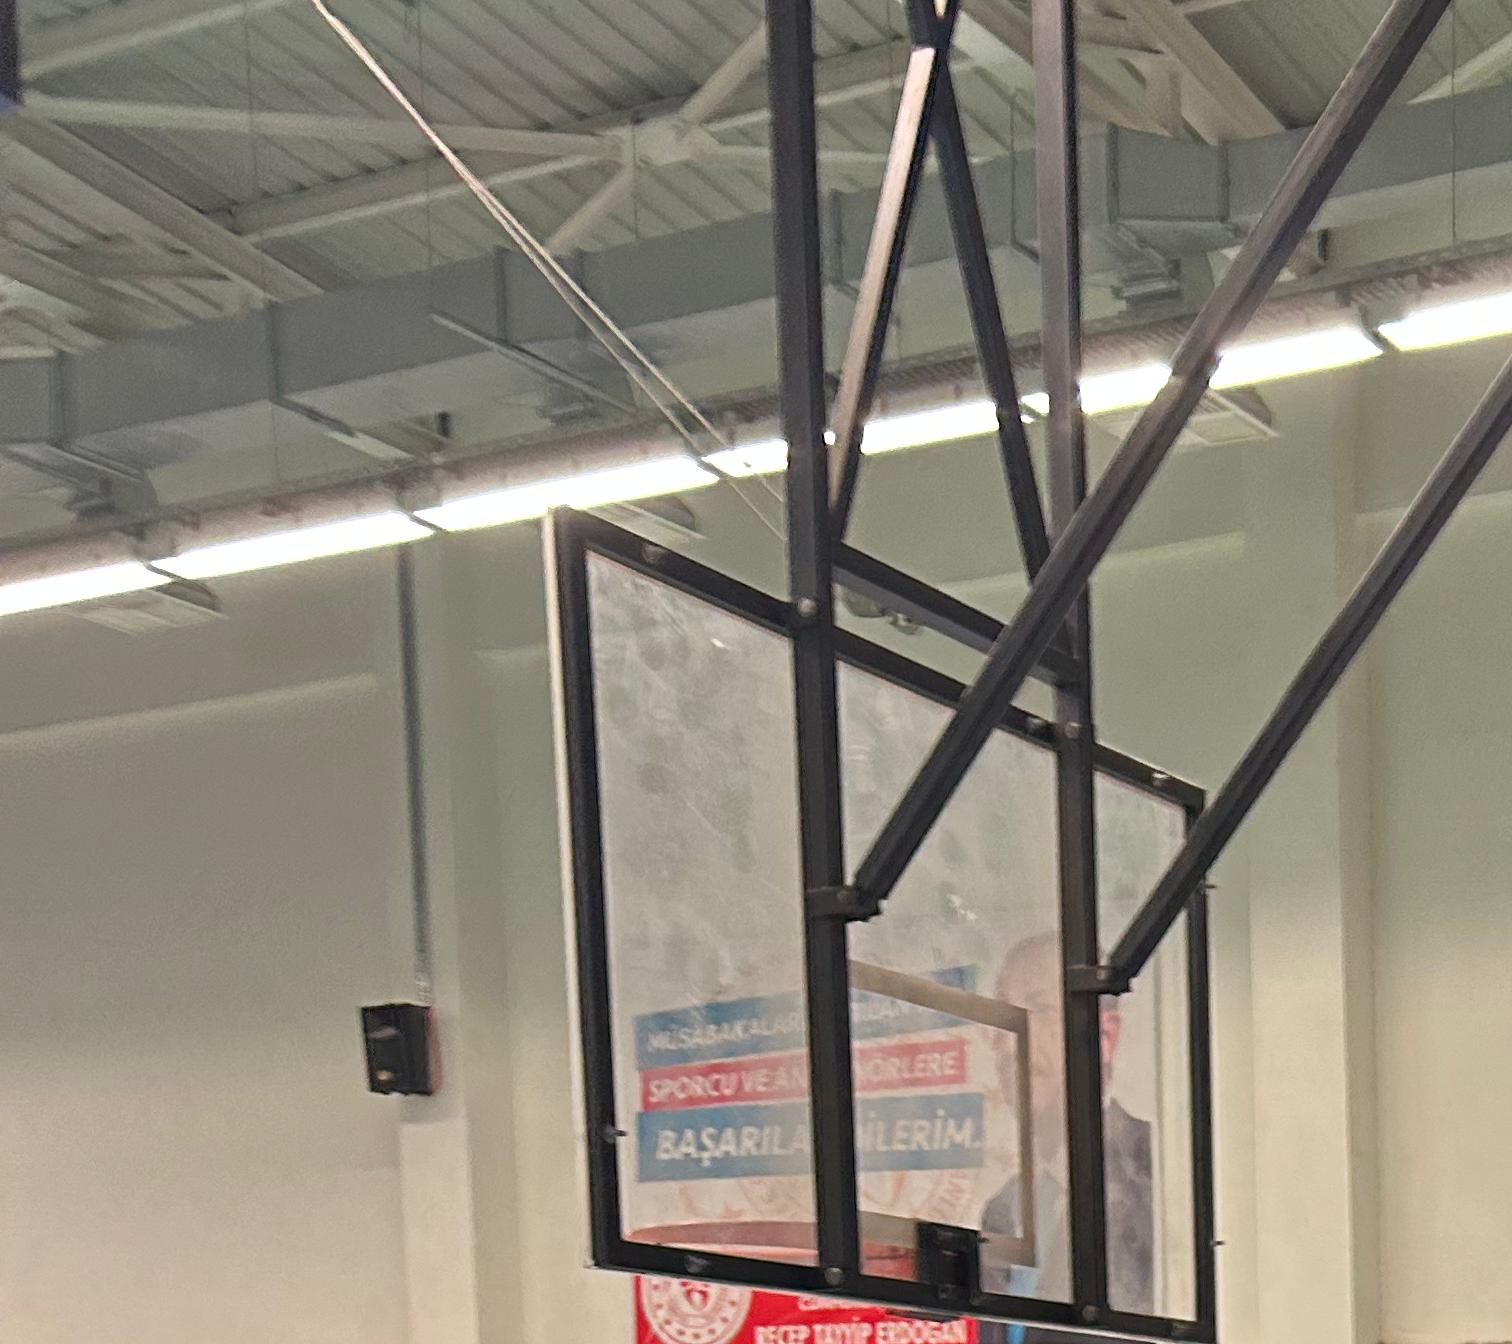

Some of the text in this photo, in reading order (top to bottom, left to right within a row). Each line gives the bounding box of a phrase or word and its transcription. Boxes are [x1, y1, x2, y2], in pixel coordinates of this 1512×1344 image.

[648, 1071, 740, 1103] SPORCU
[741, 1068, 770, 1092] VE
[655, 1107, 984, 1167] BAŞARILA İLERİM.
